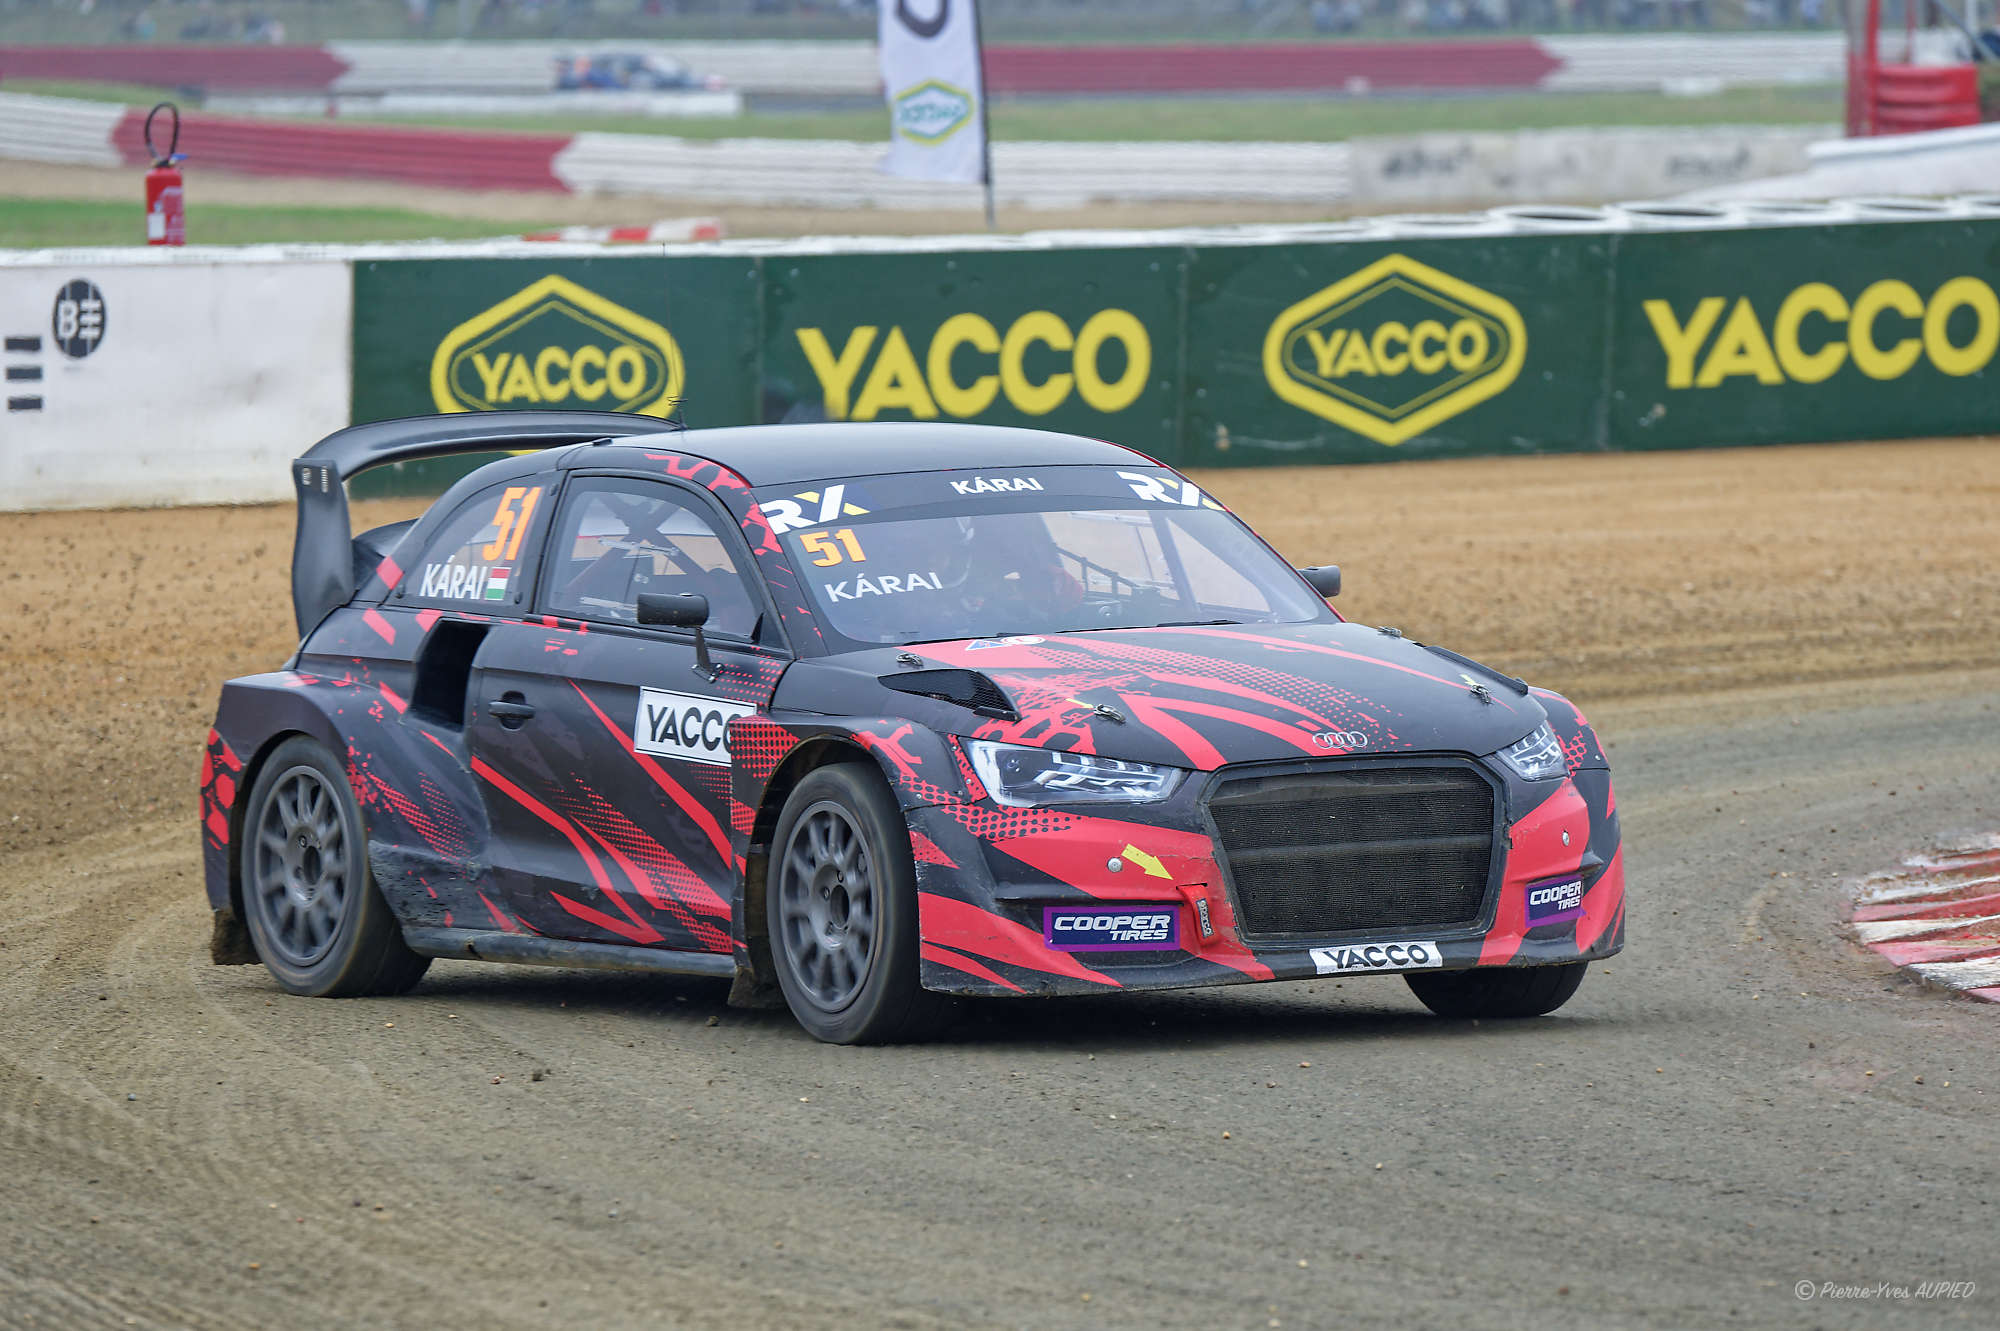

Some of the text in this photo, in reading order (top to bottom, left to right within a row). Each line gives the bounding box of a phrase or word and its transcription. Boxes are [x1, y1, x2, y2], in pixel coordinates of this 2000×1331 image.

[1305, 318, 1489, 378] YACCO
[1642, 276, 2000, 389] YACCO
[472, 345, 647, 403] YACCO
[795, 308, 1151, 421] YACCO
[950, 476, 1044, 495] KÁRAI
[482, 486, 542, 561] 51
[759, 484, 871, 535] RX
[800, 529, 867, 567] 51
[419, 555, 488, 600] KÁRAI
[824, 571, 944, 603] KÁRAI
[1529, 880, 1582, 905] COOPER
[1557, 895, 1581, 911] TIRES
[1054, 915, 1171, 931] COOPER
[1109, 929, 1169, 941] TIRES
[1323, 944, 1430, 969] YACCO
